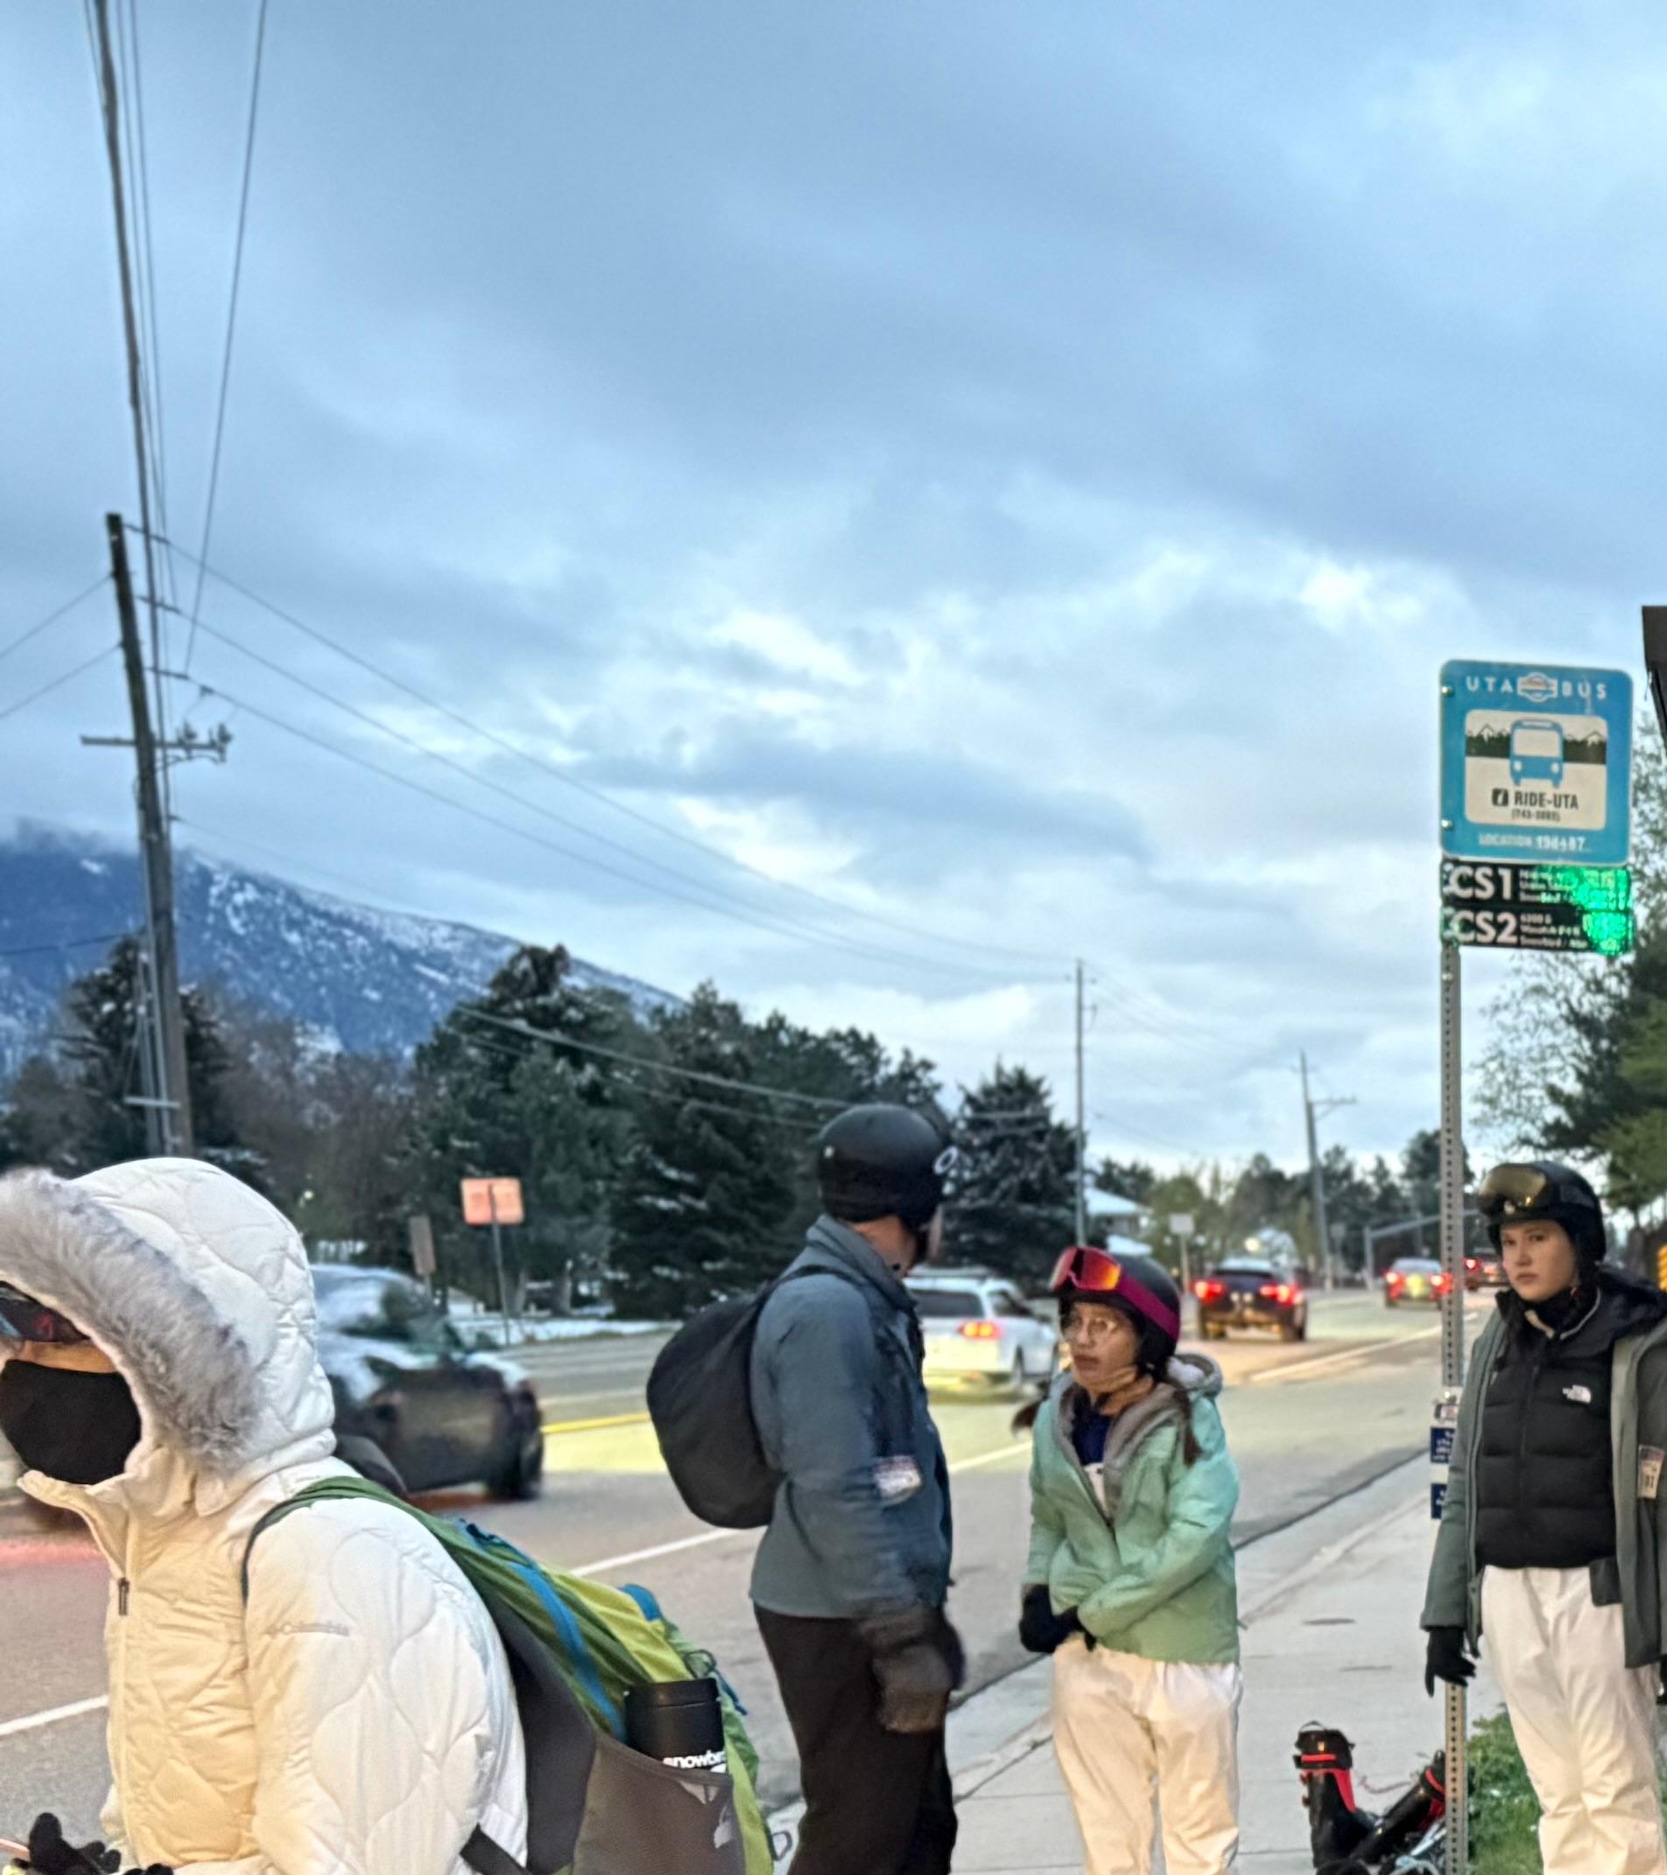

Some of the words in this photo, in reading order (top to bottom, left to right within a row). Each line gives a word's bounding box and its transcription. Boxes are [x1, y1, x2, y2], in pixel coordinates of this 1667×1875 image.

[1465, 677, 1513, 693] UTA
[1562, 681, 1607, 699] BUS
[1514, 790, 1579, 810] RIDE-UTA
[1450, 865, 1512, 900] CS1
[1452, 910, 1518, 944] CS2
